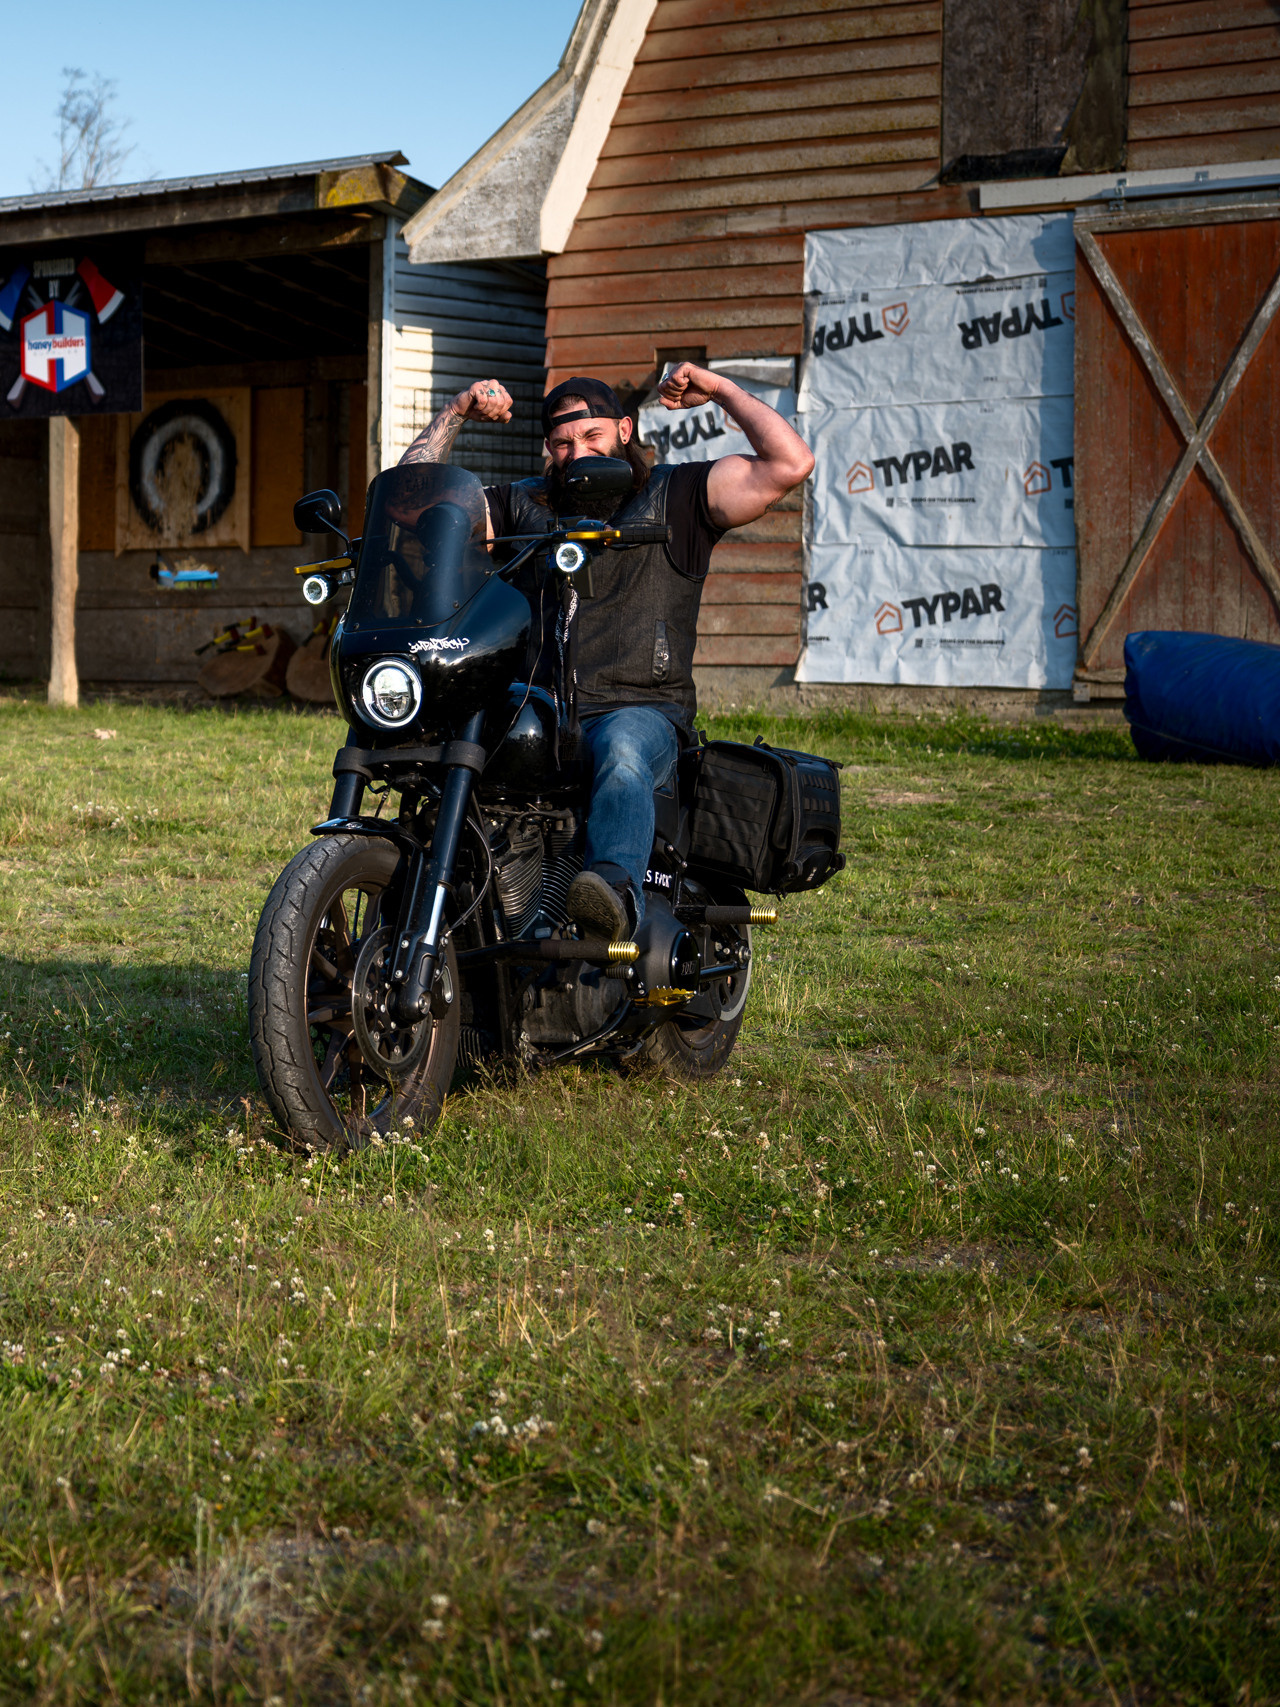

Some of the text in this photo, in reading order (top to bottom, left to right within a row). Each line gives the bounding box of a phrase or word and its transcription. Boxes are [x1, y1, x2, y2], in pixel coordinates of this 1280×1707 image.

[958, 298, 1064, 351] TYPAR
[873, 441, 975, 487] TYPAR
[901, 582, 1006, 628] TYPAR
